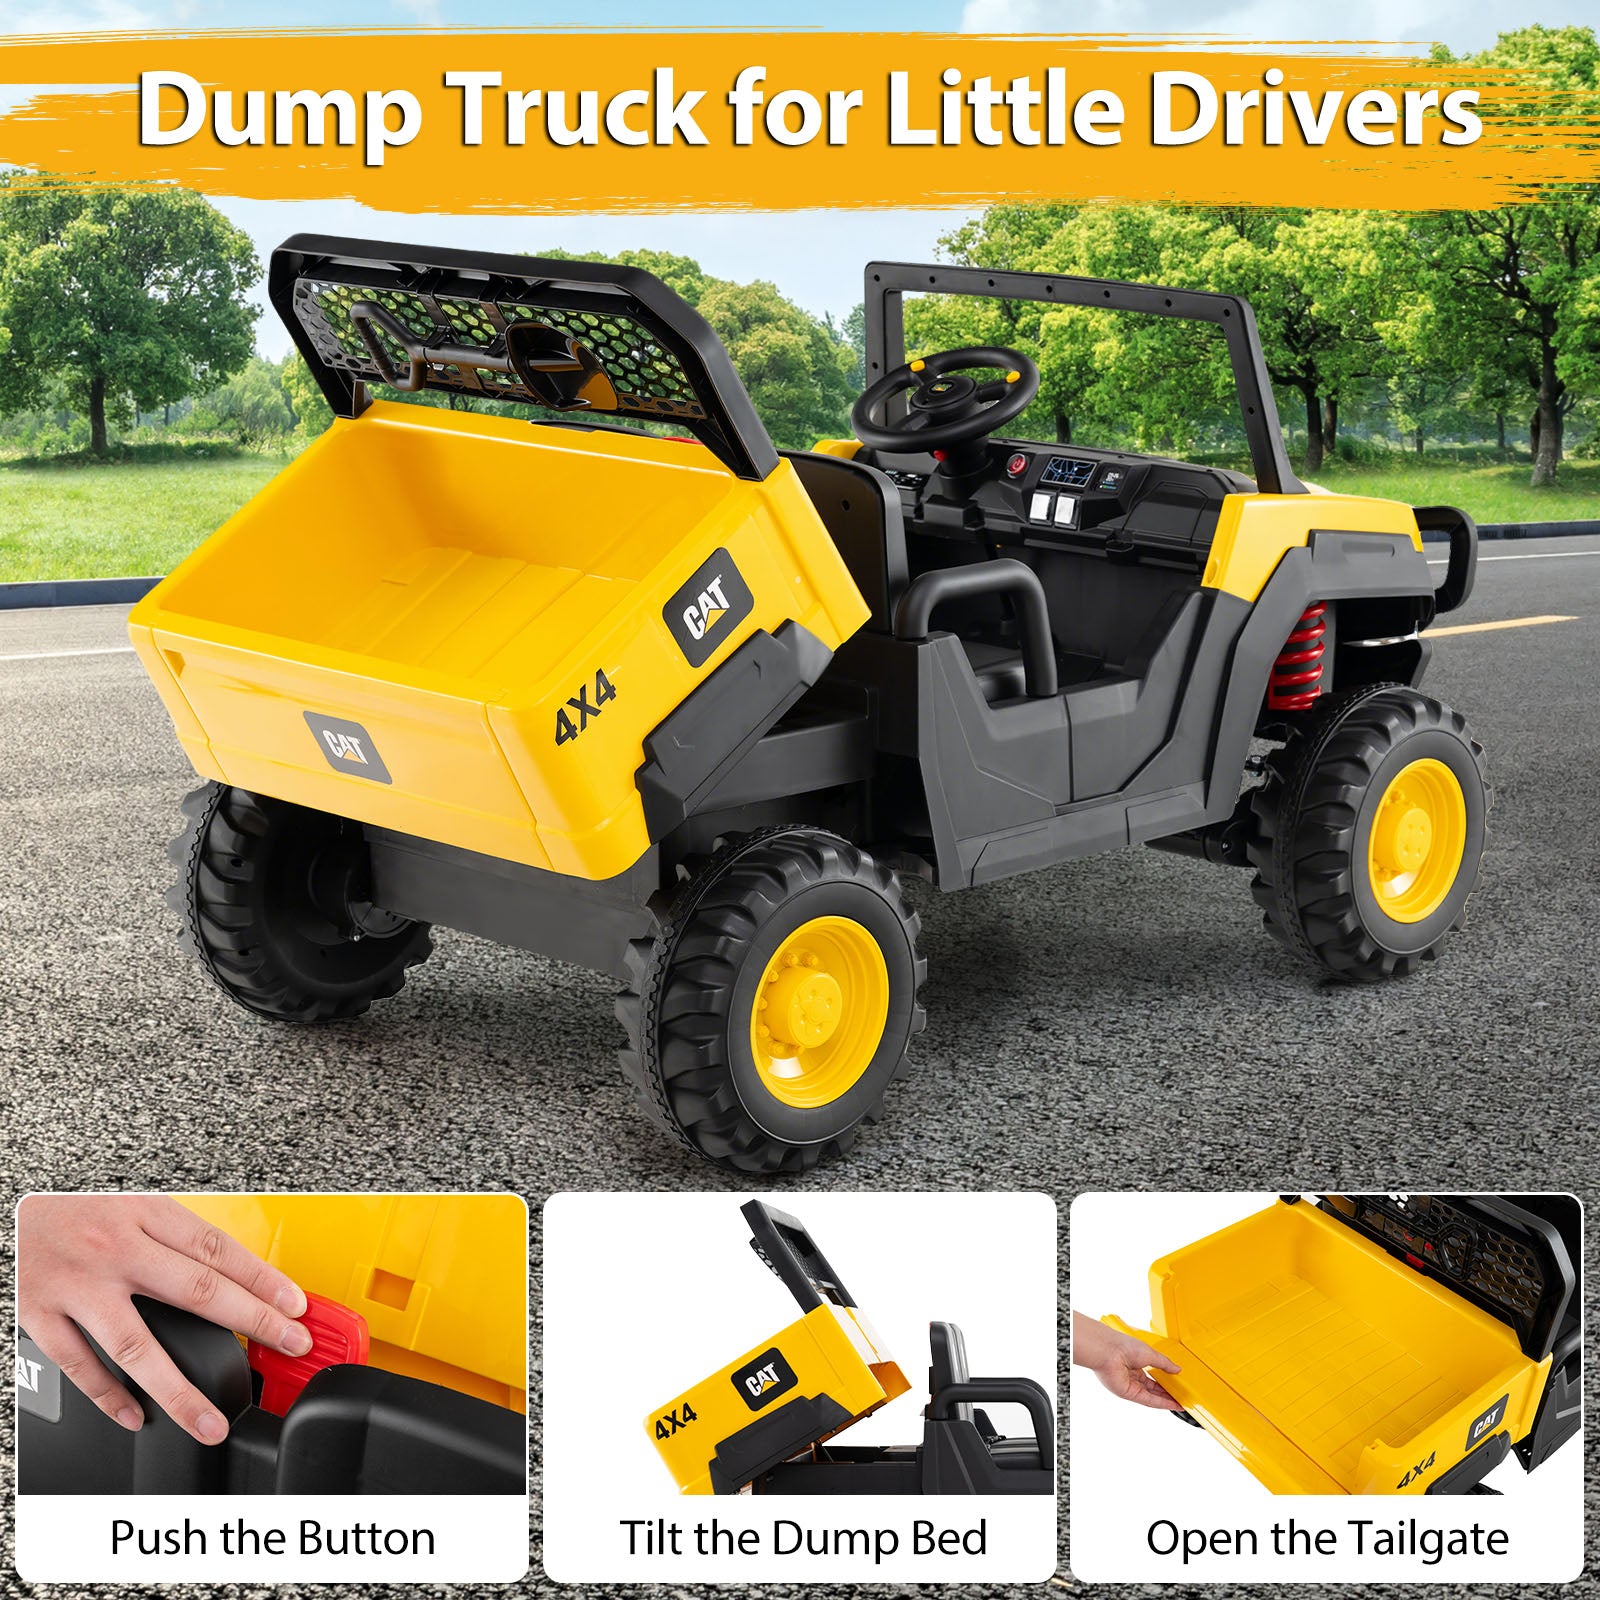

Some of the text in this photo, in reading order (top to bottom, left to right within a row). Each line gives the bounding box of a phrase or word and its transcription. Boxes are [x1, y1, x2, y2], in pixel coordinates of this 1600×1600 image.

[682, 573, 731, 641] CAT
[554, 667, 618, 747] 4X4
[322, 729, 369, 765] CAT
[745, 1362, 781, 1398] CAT
[654, 1402, 698, 1442] 4X4
[1473, 1406, 1501, 1439] CAT
[1396, 1450, 1436, 1490] 4X4
